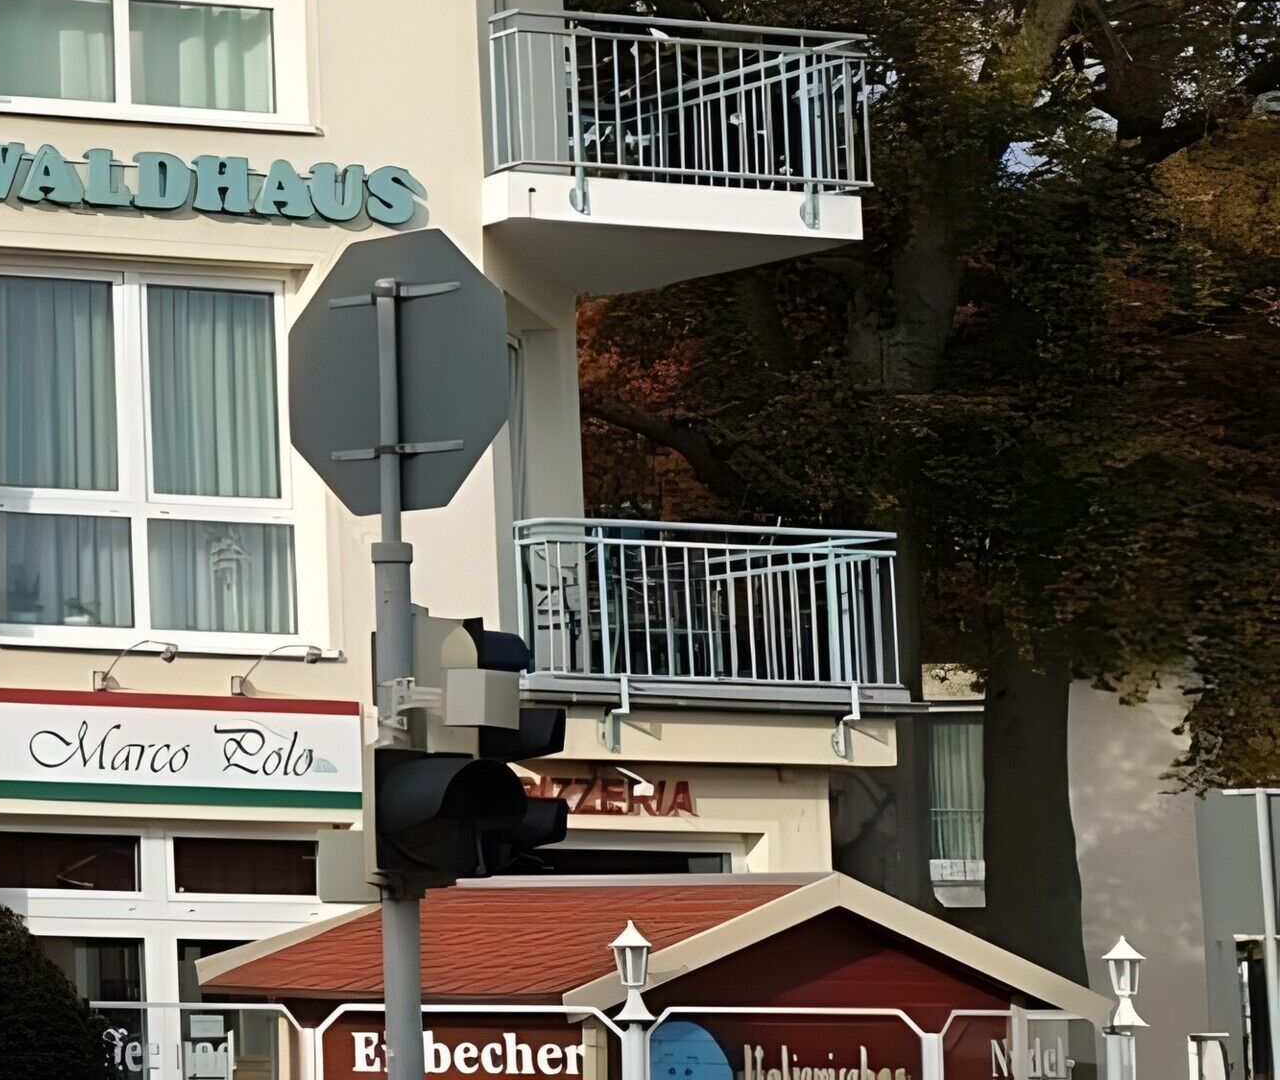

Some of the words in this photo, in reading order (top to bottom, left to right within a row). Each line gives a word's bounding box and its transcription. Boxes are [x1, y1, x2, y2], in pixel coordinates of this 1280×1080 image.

[30, 720, 190, 772] Marco
[214, 723, 314, 777] Polo
[351, 1031, 584, 1075] Ebecher
